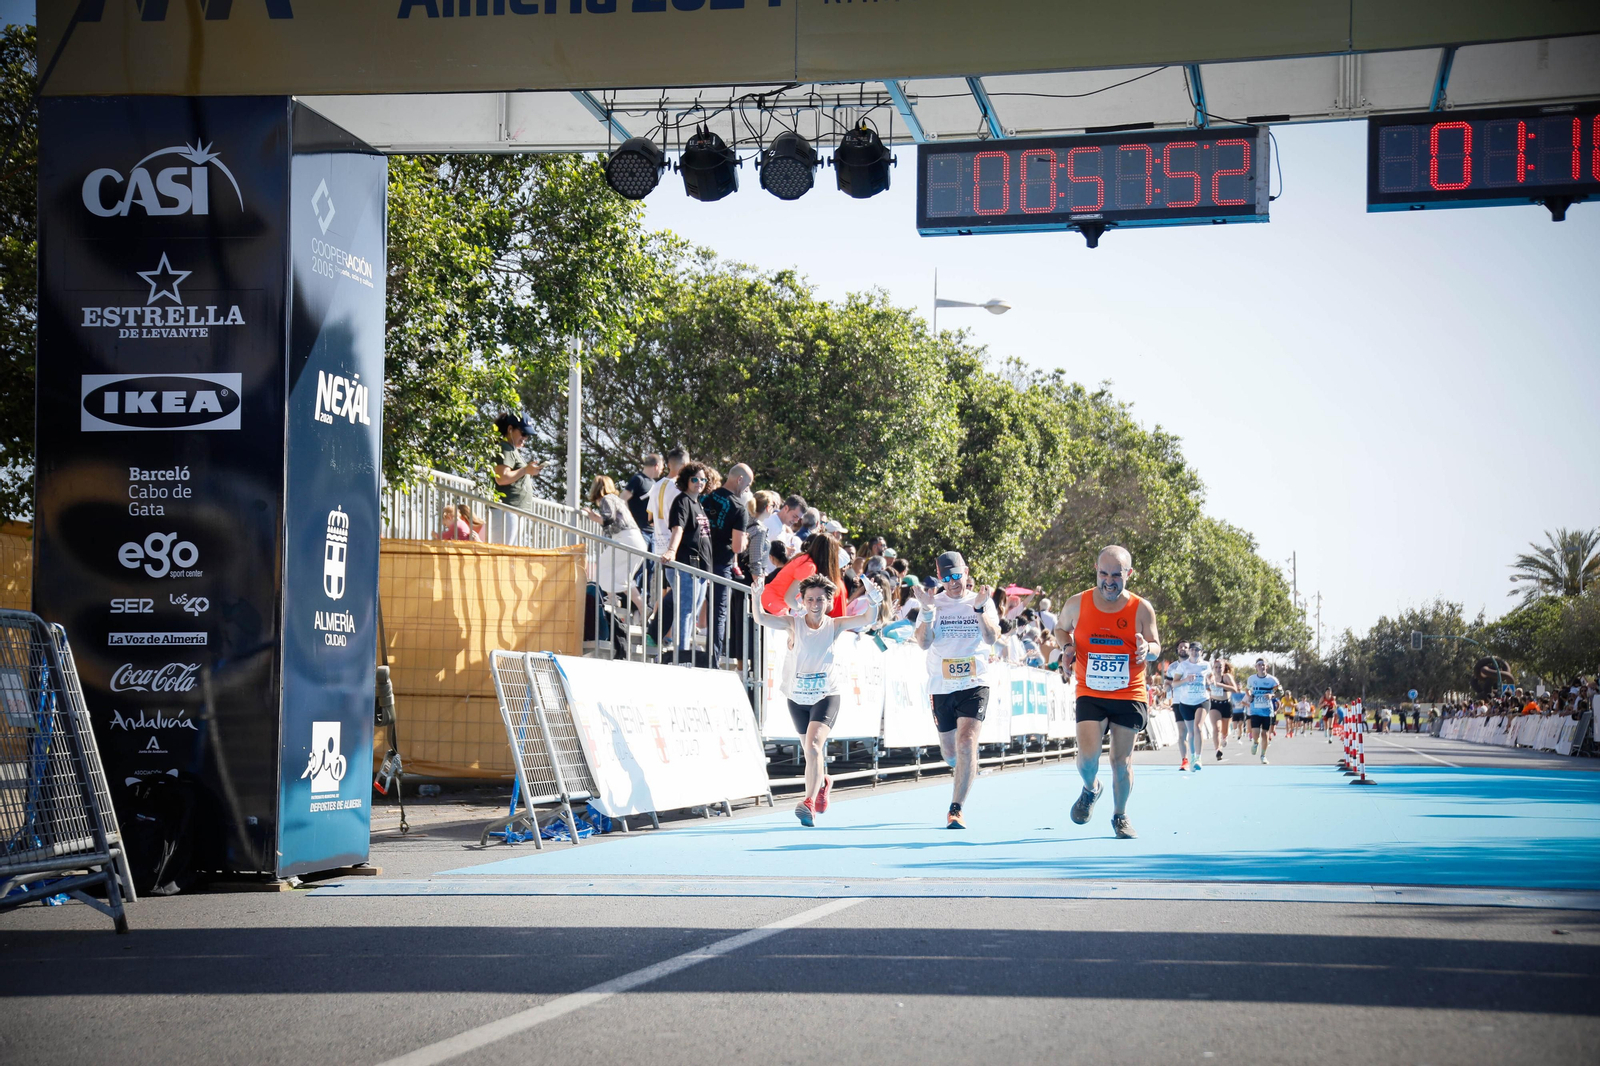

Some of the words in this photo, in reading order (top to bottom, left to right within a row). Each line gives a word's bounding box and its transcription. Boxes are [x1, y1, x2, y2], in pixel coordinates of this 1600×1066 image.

[1429, 113, 1600, 191] 01:1
[81, 166, 209, 217] CASI
[311, 237, 373, 279] COOPERACIÓN
[311, 255, 334, 279] 2005
[81, 304, 246, 327] ESTRELLA
[118, 327, 138, 339] DE
[141, 327, 209, 338] LEVANTE
[103, 390, 224, 414] IKEA
[319, 412, 334, 425] 2020
[128, 466, 191, 481] Barceló
[128, 483, 169, 499] Cabo
[172, 484, 192, 499] de
[128, 502, 166, 516] Gata
[118, 532, 199, 579] ego
[169, 569, 185, 579] sport
[185, 569, 203, 578] center
[110, 598, 154, 613] SER
[183, 597, 210, 617] 40
[314, 610, 356, 633] ALMERÍA
[109, 634, 124, 644] La
[124, 634, 146, 644] Voz
[146, 634, 160, 644] de
[161, 633, 206, 644] Almería
[324, 633, 347, 647] CIUDAD
[948, 662, 971, 674] 852
[1092, 660, 1125, 673] 5857
[109, 662, 202, 692] Coca-Cola
[109, 709, 199, 731] Andalucía
